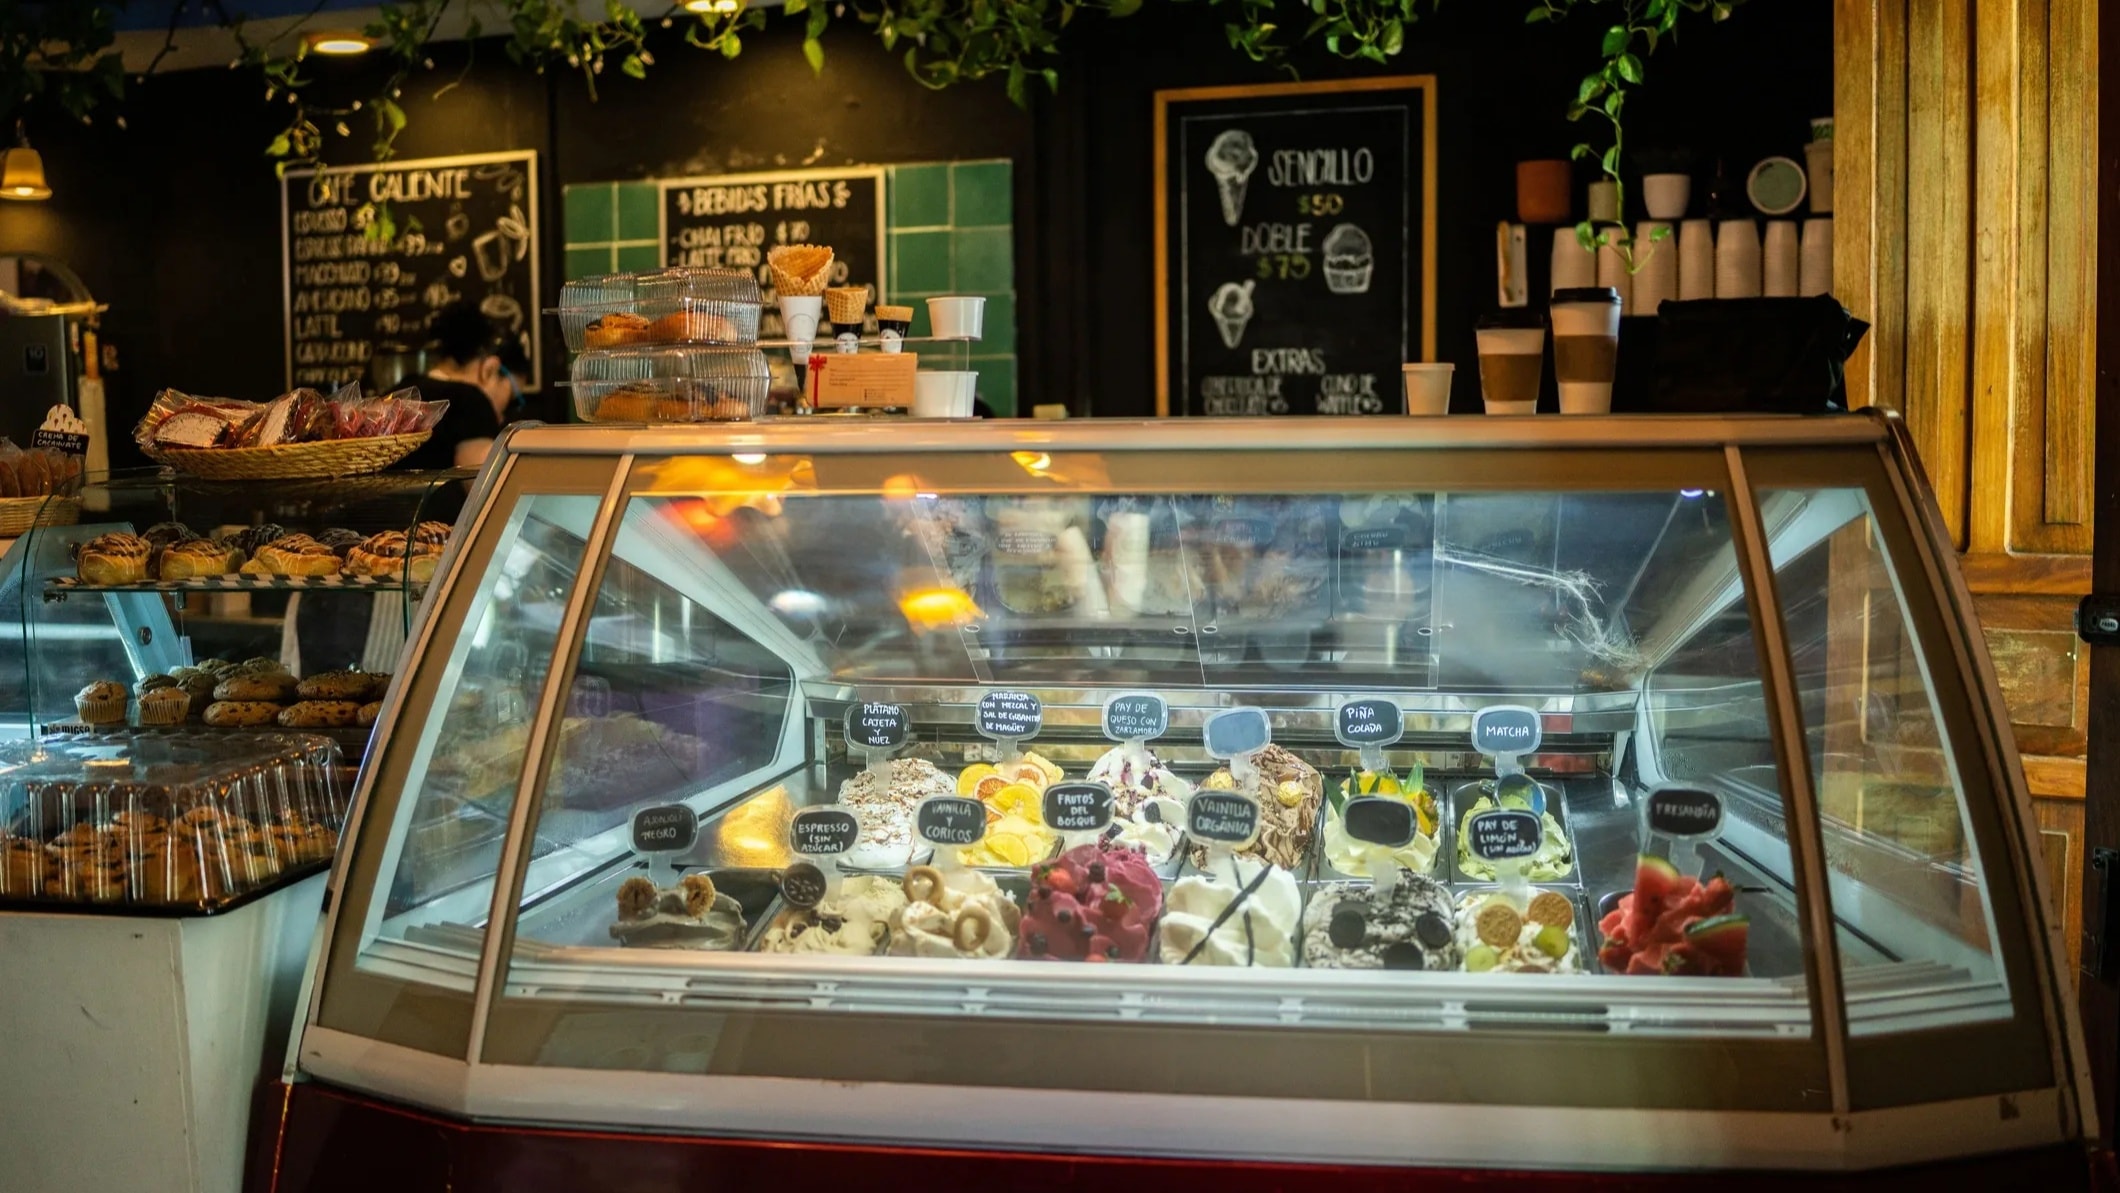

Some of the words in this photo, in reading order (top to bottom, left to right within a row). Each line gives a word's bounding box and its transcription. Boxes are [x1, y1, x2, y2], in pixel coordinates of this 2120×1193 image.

[1268, 147, 1374, 187] SENCILLO
[369, 169, 472, 202] CALIENTE
[1297, 193, 1344, 216] $50
[1241, 222, 1312, 254] DOBLE
[1256, 252, 1311, 279] $75
[1251, 347, 1327, 375] EXTRAS
[38, 432, 64, 440] CREMA
[992, 692, 1029, 701] NARANJA
[982, 701, 996, 709] CON
[1001, 702, 1028, 710] MEZCAL
[1030, 702, 1037, 711] Y
[1115, 702, 1132, 713] PAY
[1135, 703, 1149, 714] DE
[983, 710, 997, 719] SAL
[998, 711, 1008, 719] DE
[1346, 706, 1375, 719] PIÑA
[862, 717, 898, 727] CAJETA
[985, 721, 994, 730] DE
[1110, 714, 1137, 725] QUESO
[1140, 716, 1157, 727] CON
[873, 728, 881, 736] Y
[1347, 723, 1382, 734] COLADA
[1486, 726, 1530, 737] MATCHA
[868, 736, 891, 745] NUEZ
[1057, 793, 1095, 805] FRUTOS
[931, 801, 971, 816] VAINILLA
[1070, 805, 1088, 815] DEL
[1197, 798, 1252, 818] VAINILLA
[946, 817, 953, 827] Y
[1057, 815, 1096, 827] BOSQUE
[1477, 820, 1497, 832] PAY
[1501, 820, 1518, 831] DE
[640, 827, 677, 841] NEGRO
[798, 822, 850, 834] ESPRESSO
[925, 825, 973, 843] CORICOS
[809, 834, 832, 843] (SIN
